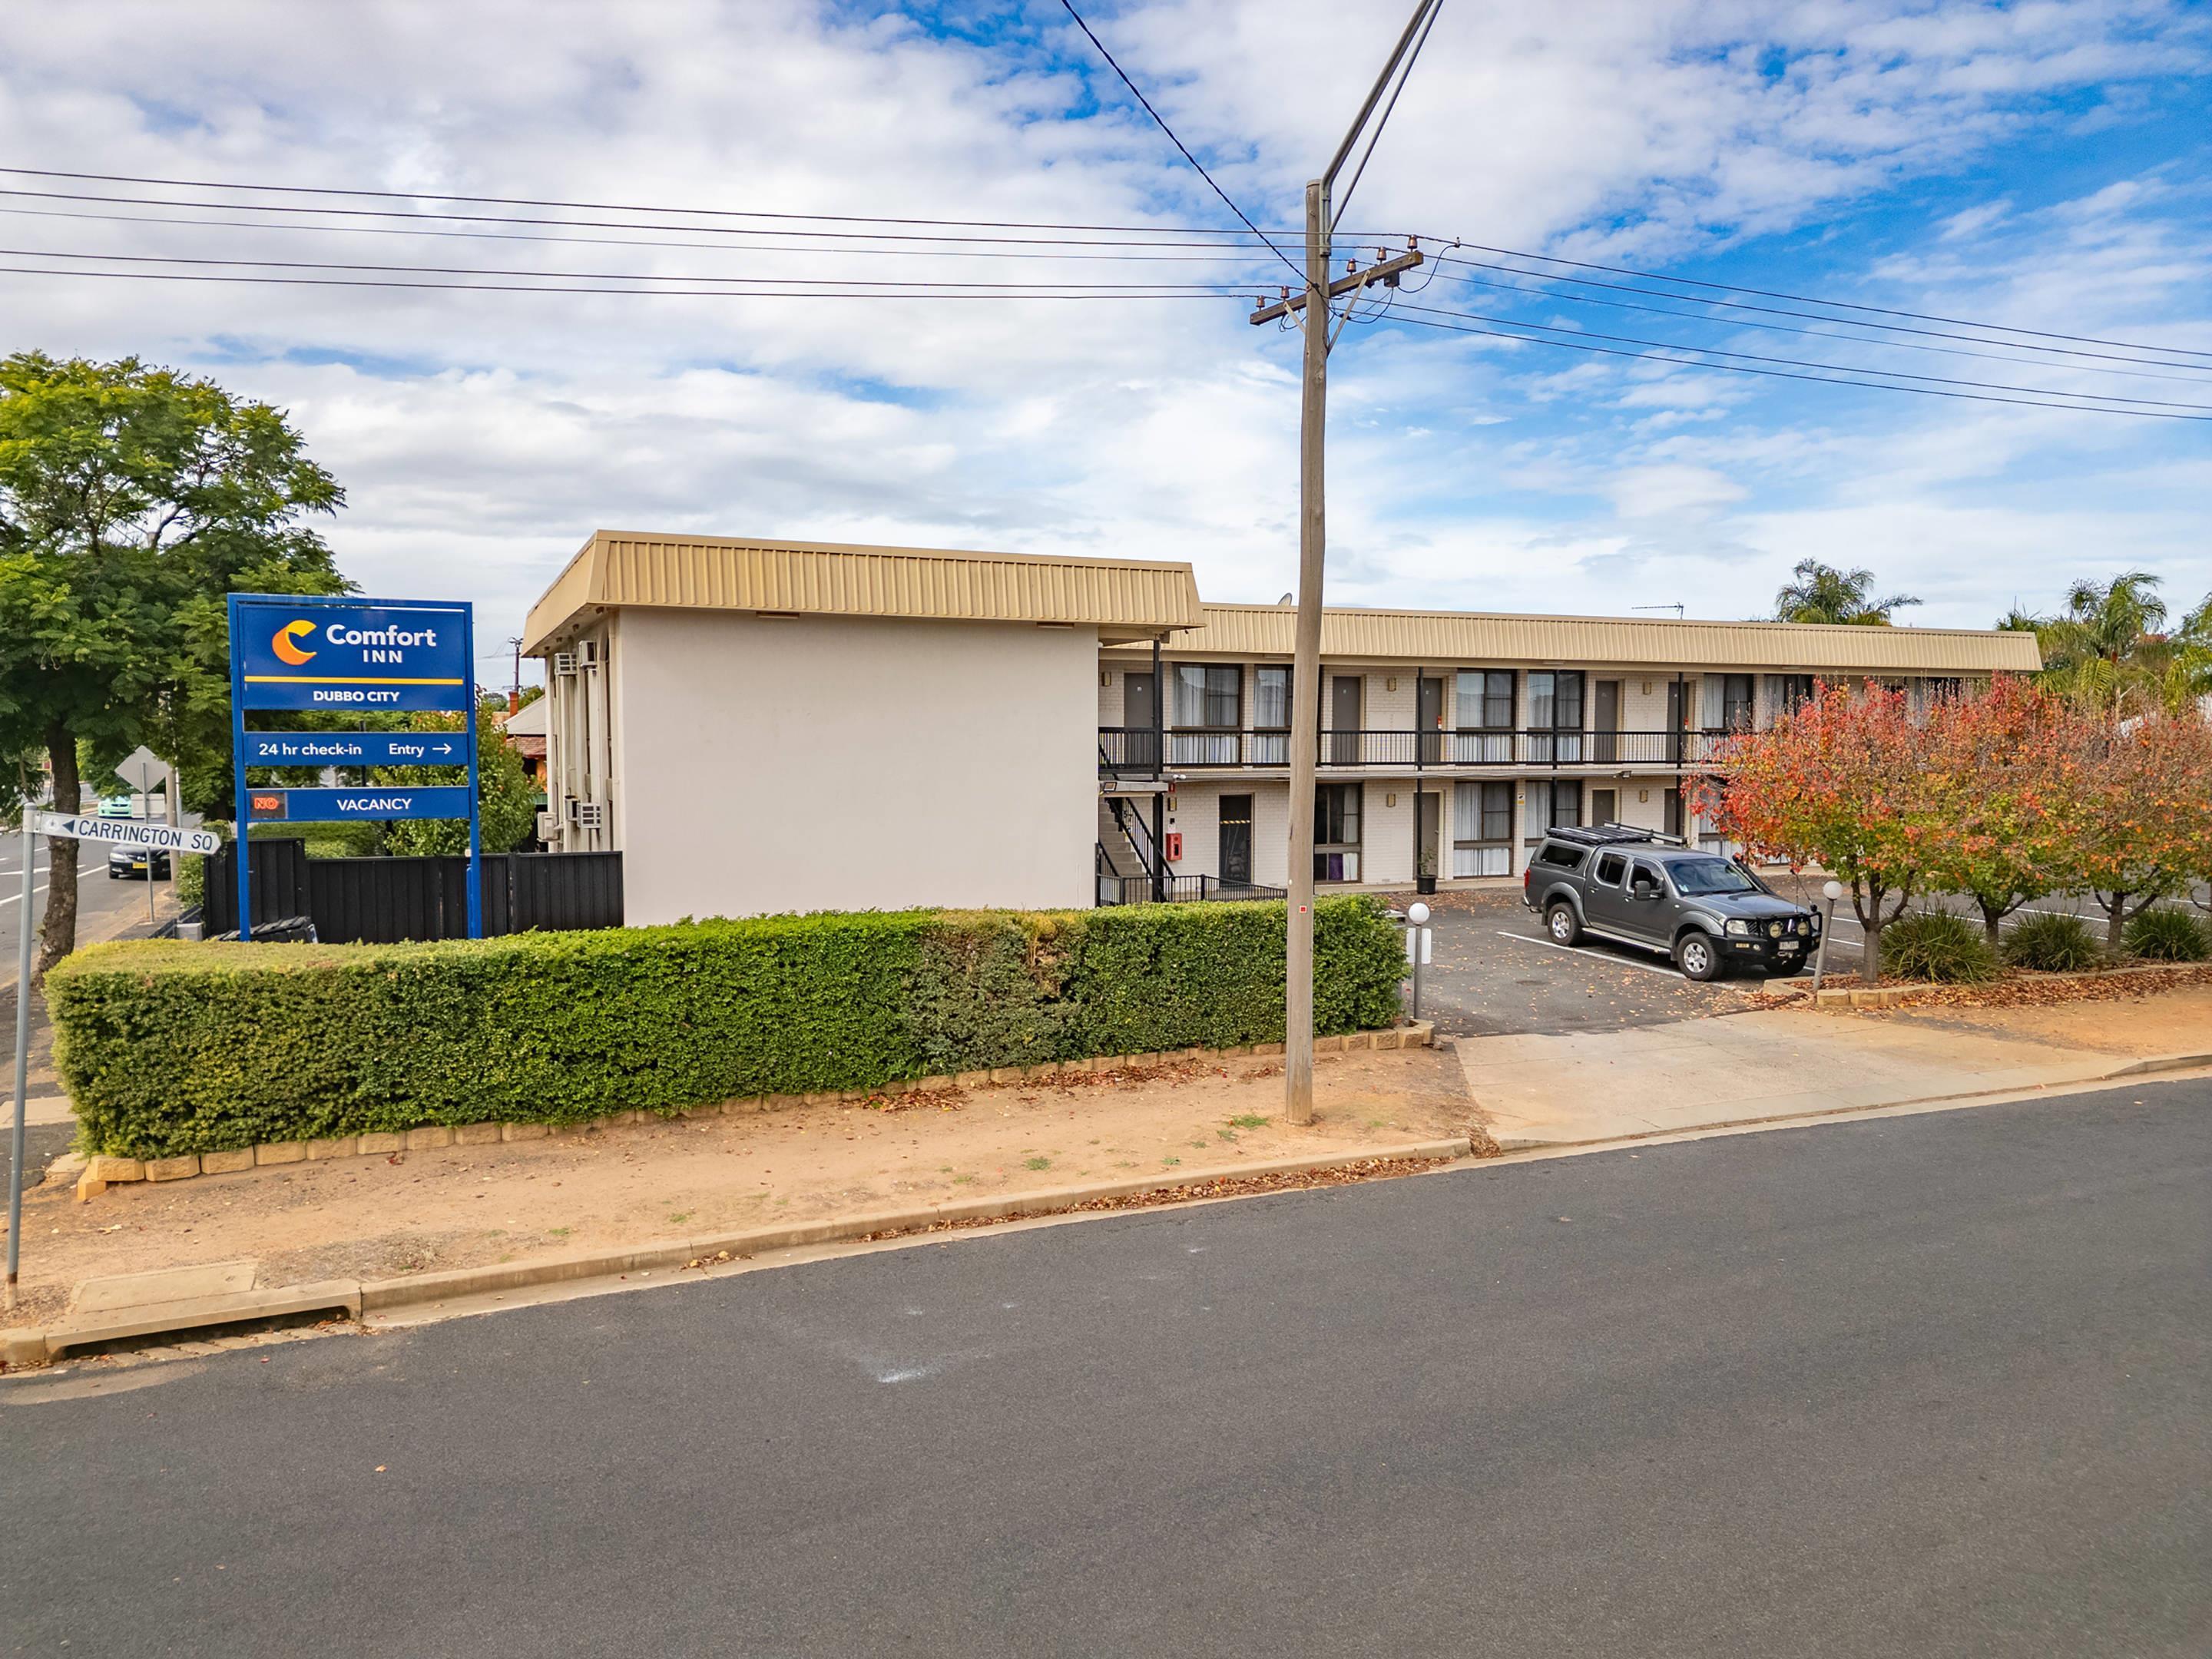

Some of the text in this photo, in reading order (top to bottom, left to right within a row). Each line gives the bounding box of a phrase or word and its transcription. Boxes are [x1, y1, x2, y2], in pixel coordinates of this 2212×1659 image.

[326, 624, 436, 647] Comfort
[363, 650, 402, 663] INN
[313, 690, 399, 702] DUBBO CITY
[259, 743, 424, 757] 24 hr check-in Entry
[254, 797, 412, 810] NO VACANCY
[78, 820, 213, 851] CARRINGTON SQ
